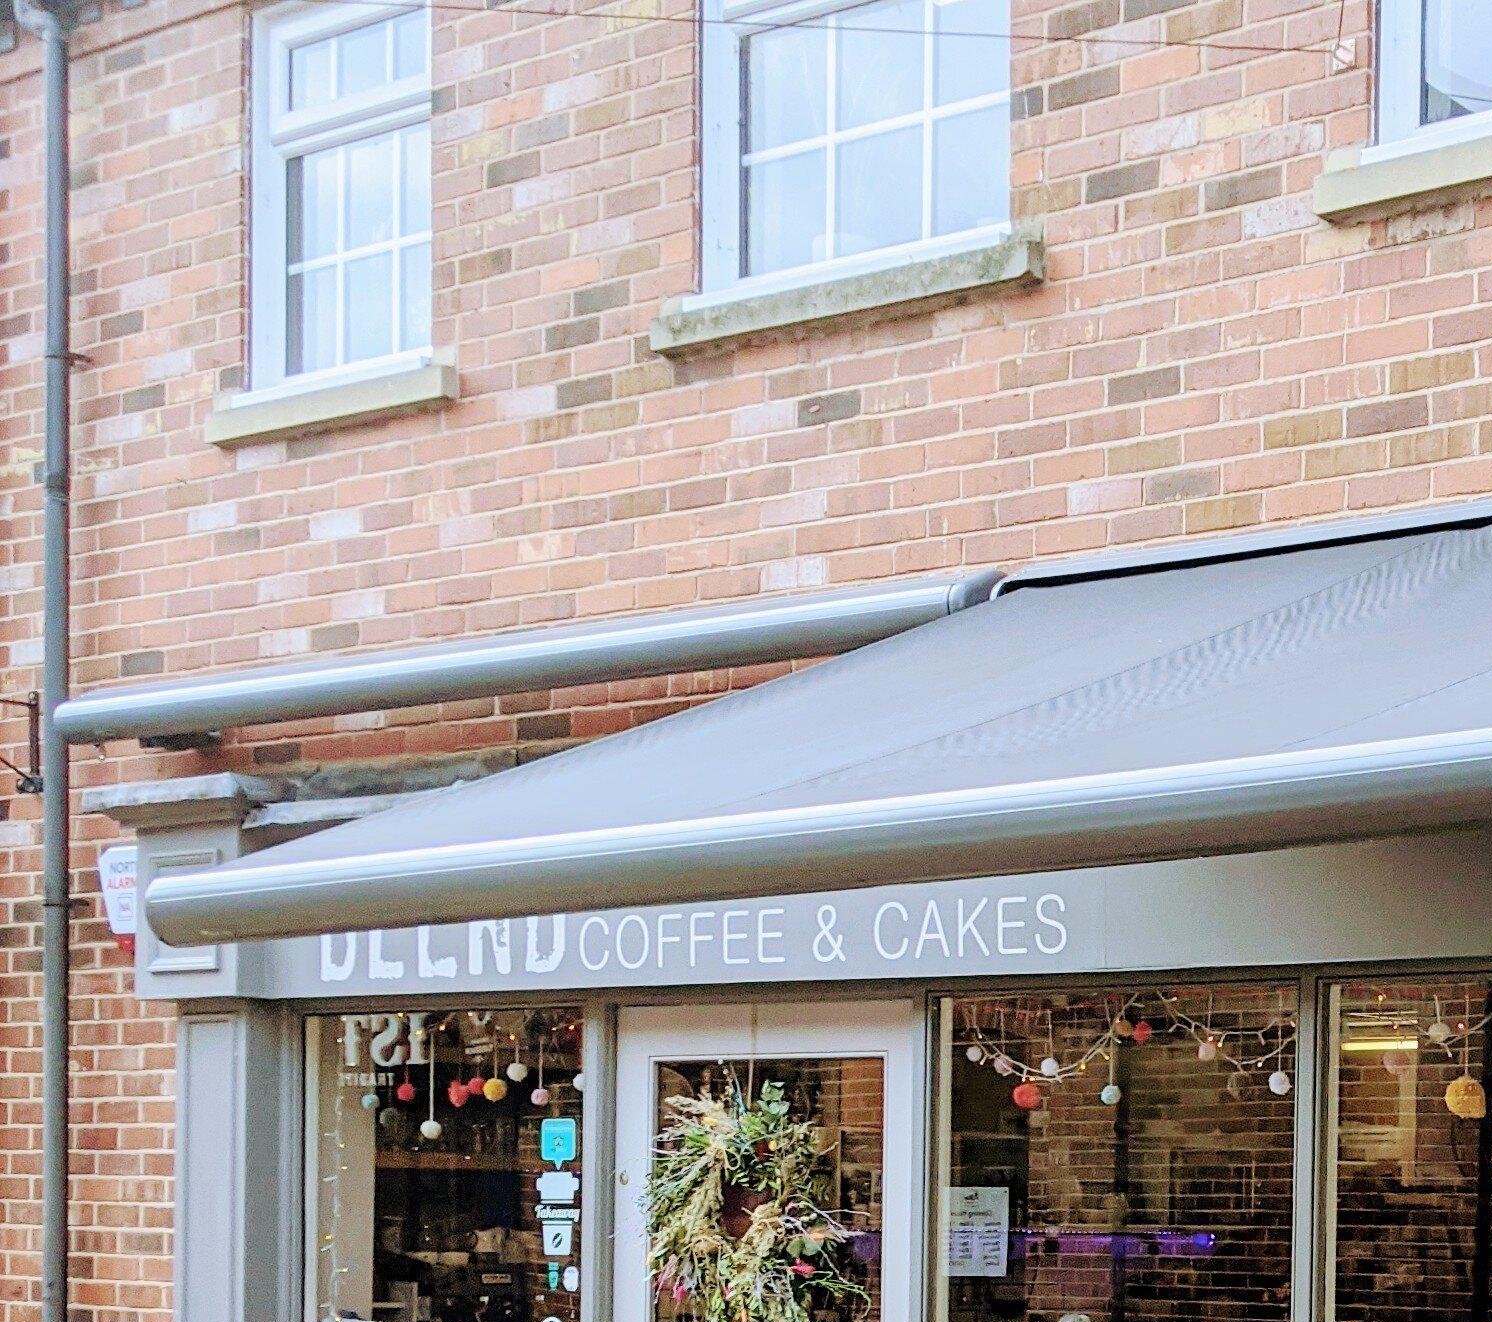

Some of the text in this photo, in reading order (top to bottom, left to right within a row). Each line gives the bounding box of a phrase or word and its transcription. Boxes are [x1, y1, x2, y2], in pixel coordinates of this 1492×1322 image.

[578, 908, 786, 972] COFFEE
[812, 904, 847, 963] &
[873, 893, 1068, 961] CAKES
